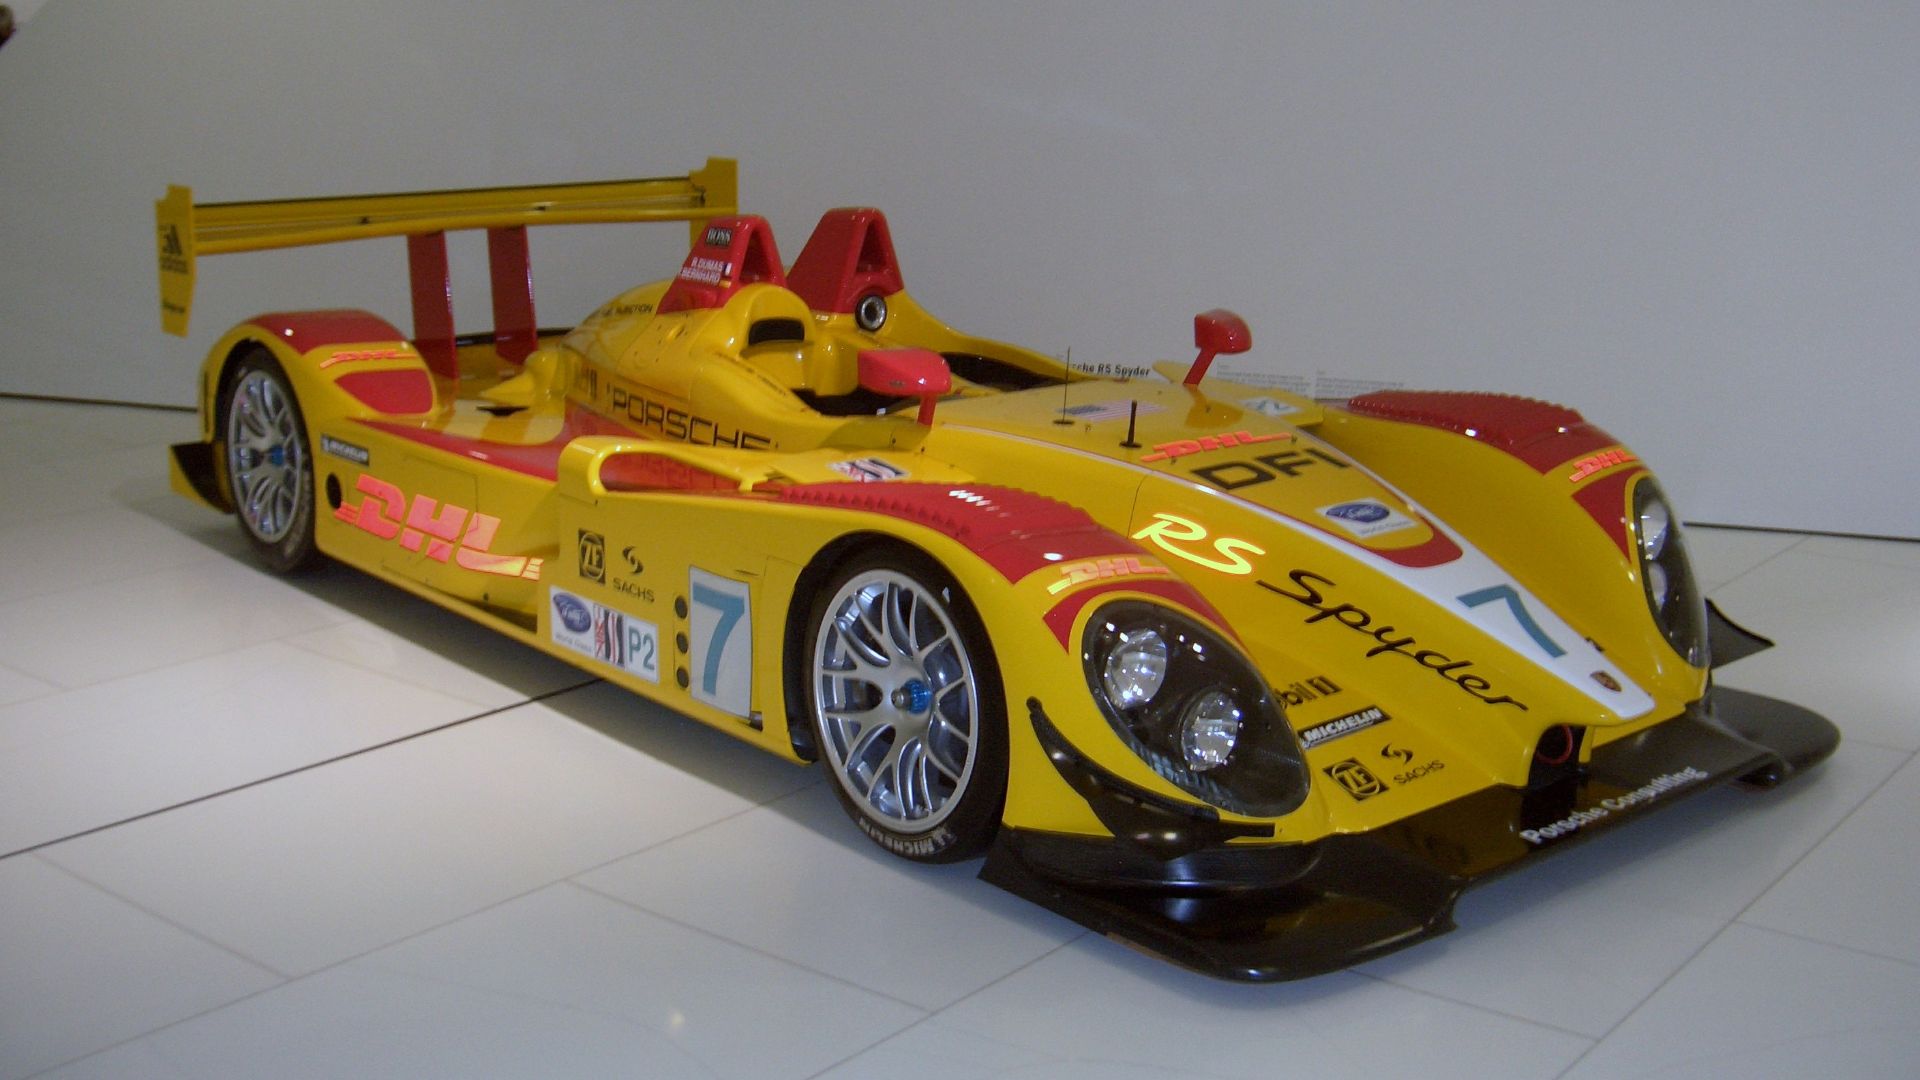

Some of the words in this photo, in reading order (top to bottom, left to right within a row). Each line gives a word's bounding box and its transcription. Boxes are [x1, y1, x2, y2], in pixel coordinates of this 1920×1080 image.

[1114, 364, 1151, 377] Spyder
[613, 387, 772, 450] PORSCHE
[1145, 431, 1290, 460] DHL
[350, 473, 531, 579] DHL
[612, 578, 655, 602] SACHS
[1054, 558, 1170, 590] DHL
[1132, 513, 1266, 575] RS
[1256, 569, 1529, 712] Spyder
[1456, 583, 1568, 659] 7
[628, 627, 655, 671] P2
[692, 581, 746, 697] 7
[1303, 707, 1384, 743] MICHELIN
[1394, 759, 1446, 785] SACHS
[1519, 807, 1609, 845] Porsche
